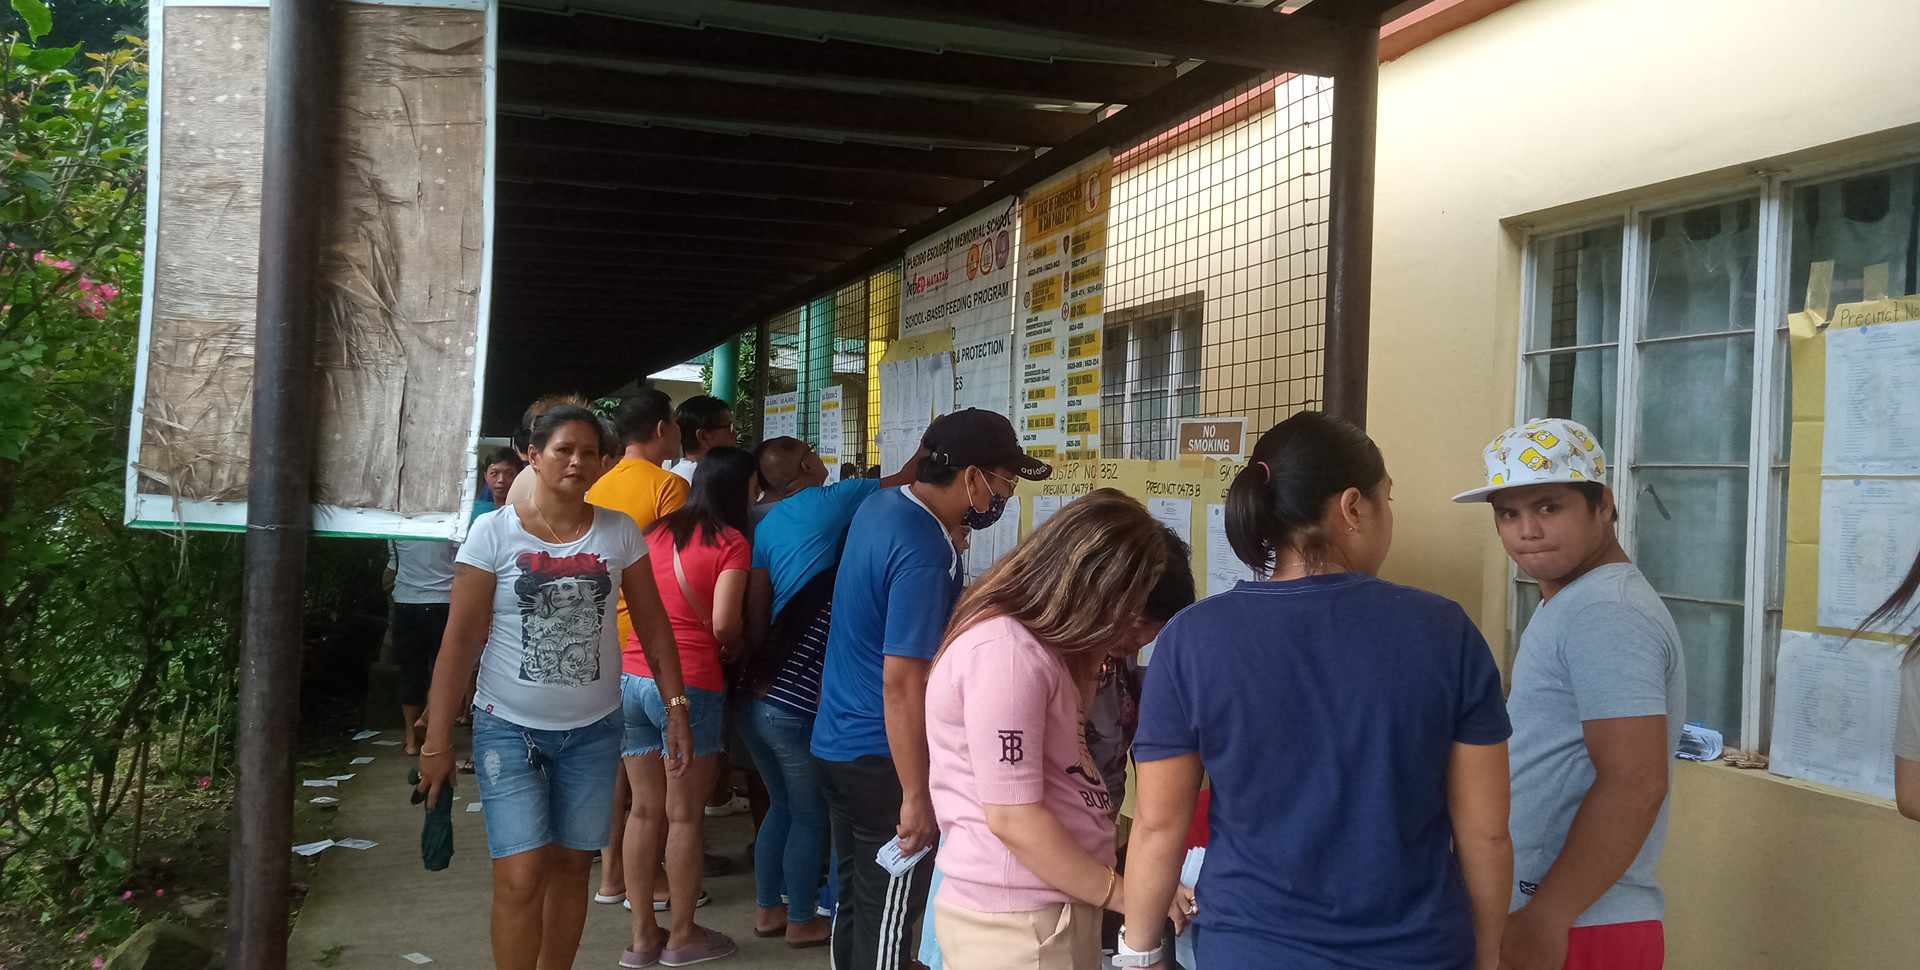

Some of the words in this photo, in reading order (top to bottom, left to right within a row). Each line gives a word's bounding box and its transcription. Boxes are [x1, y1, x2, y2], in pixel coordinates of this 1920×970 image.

[954, 224, 986, 248] MEMORIAL
[986, 213, 1011, 235] SCHOOL
[904, 303, 946, 329] SCHOOL-BASED
[945, 295, 972, 316] FEEDING
[973, 281, 1009, 305] PROGRAM
[1840, 301, 1900, 328] Precinct
[961, 339, 1004, 361] PROTECTION
[954, 376, 964, 390] ES
[1202, 424, 1216, 438] NO
[1188, 438, 1230, 452] SMOKING
[1084, 464, 1097, 480] NO
[1100, 463, 1119, 480] 352
[1145, 480, 1177, 496] PRECINCT
[1078, 790, 1112, 811] BUR
